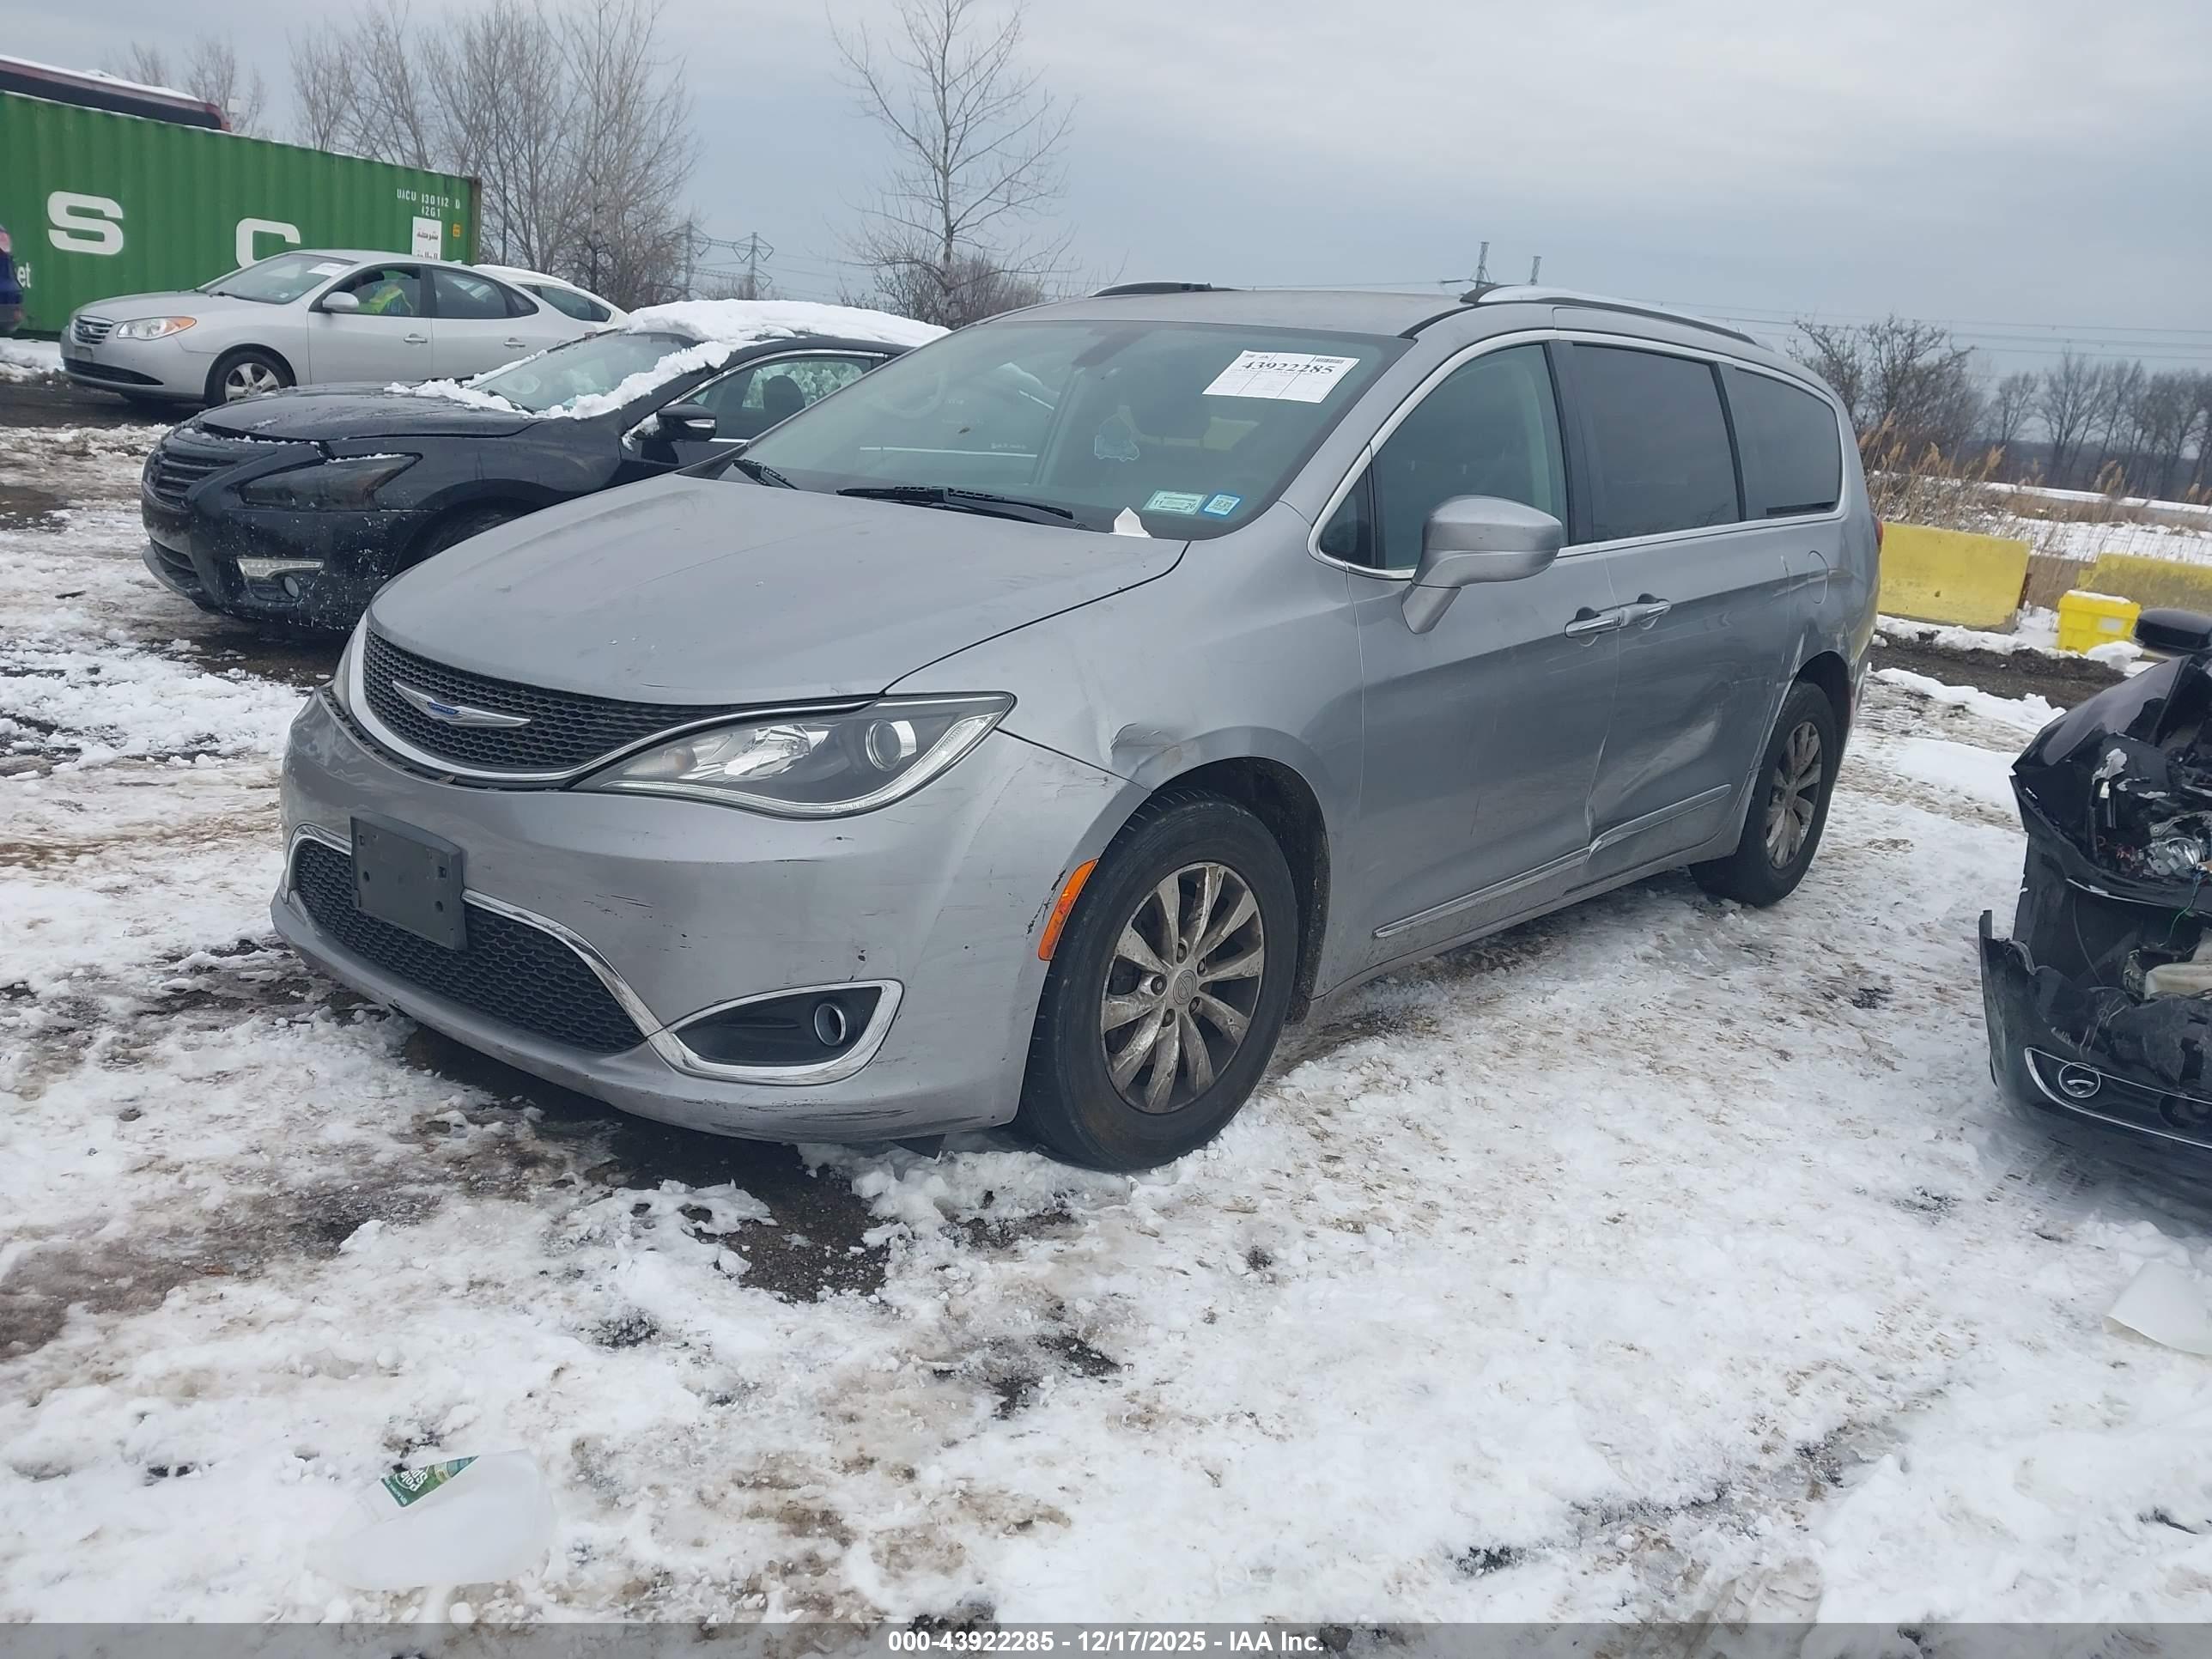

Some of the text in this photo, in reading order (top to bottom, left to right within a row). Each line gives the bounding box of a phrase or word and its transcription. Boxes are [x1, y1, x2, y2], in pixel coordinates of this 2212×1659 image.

[397, 187, 416, 201] UACU
[1242, 361, 1336, 374] 43922285
[400, 1471, 421, 1492] Pola
